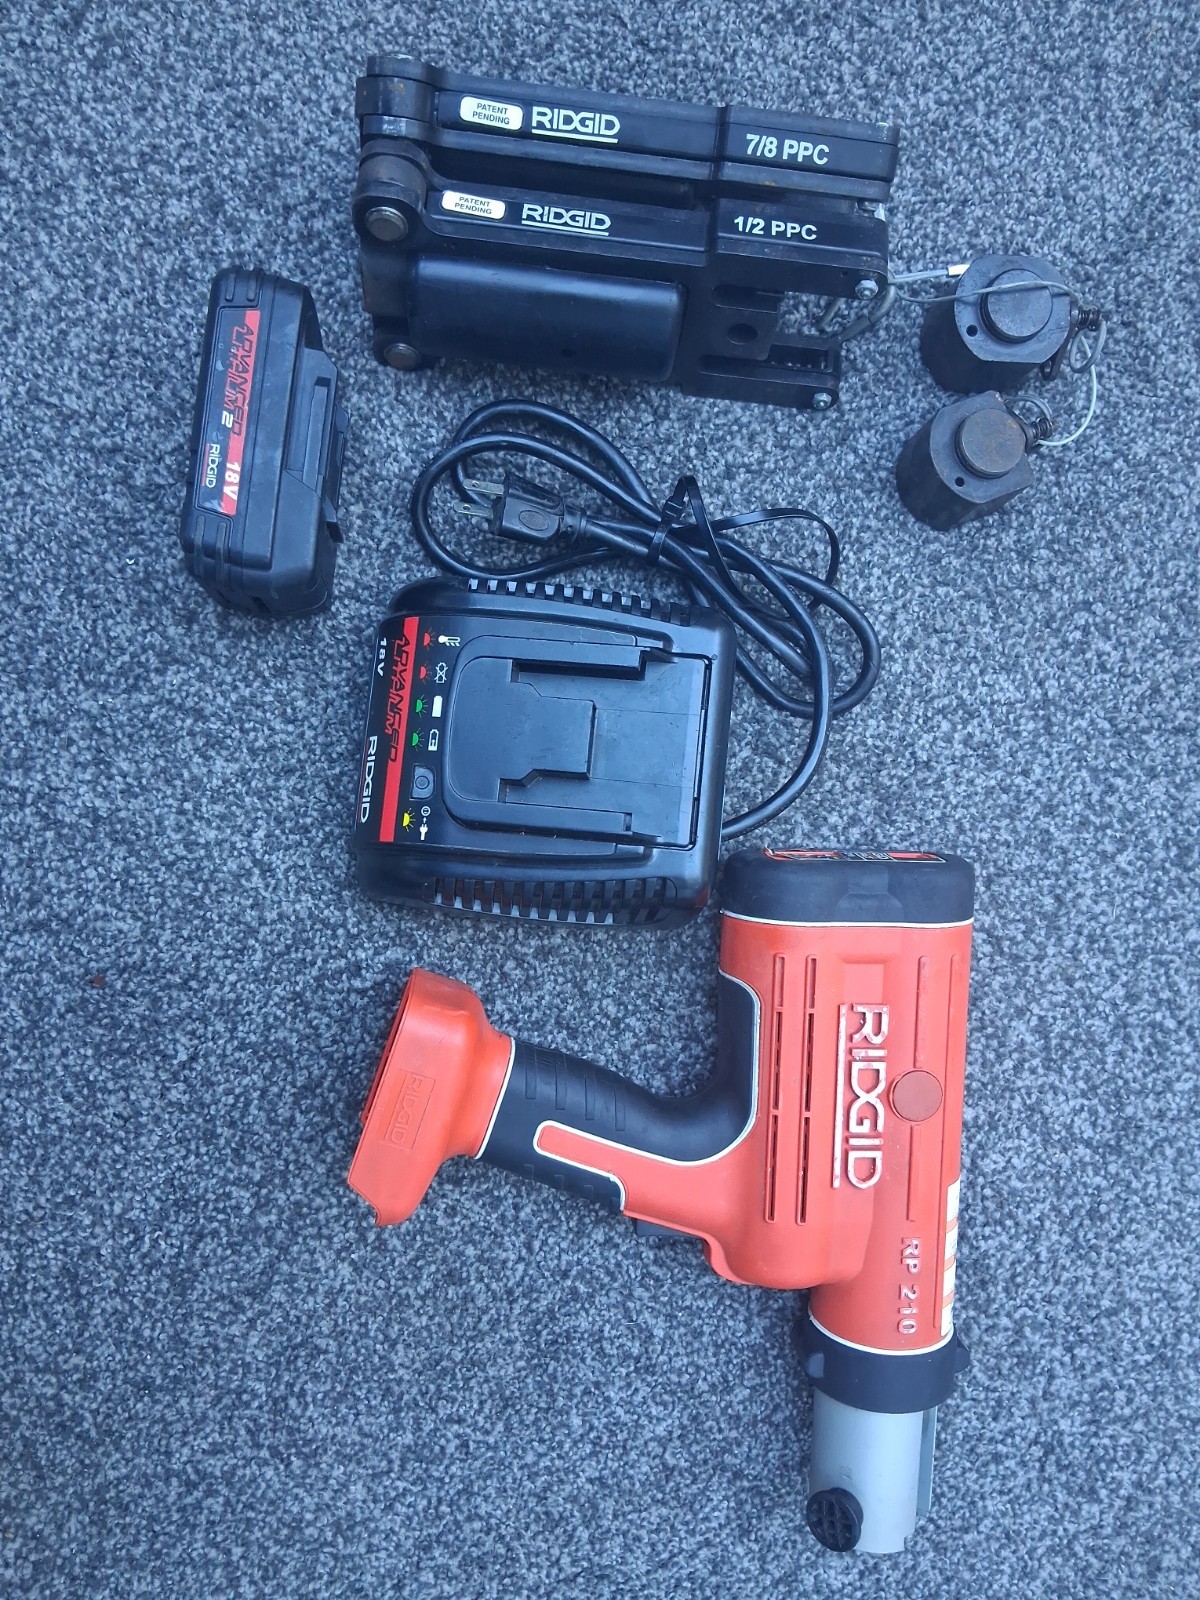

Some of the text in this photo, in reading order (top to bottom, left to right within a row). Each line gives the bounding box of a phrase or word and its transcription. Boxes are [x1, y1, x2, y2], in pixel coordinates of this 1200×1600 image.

[472, 110, 510, 125] PENDING
[476, 102, 508, 117] PATENT
[531, 106, 620, 136] RIDGID
[745, 134, 830, 165] 7/8 PPC
[454, 202, 493, 216] PENDING
[458, 196, 491, 210] PATENT
[521, 203, 611, 230] RIDGID
[733, 216, 818, 241] 1/2 PPC
[222, 410, 233, 428] 2
[206, 444, 220, 488] RIDGID
[223, 462, 241, 500] 18V
[360, 736, 378, 823] RIDGID
[390, 1074, 422, 1143] RIDGID
[848, 1004, 890, 1188] RIDGID
[898, 1238, 922, 1335] RP 210
